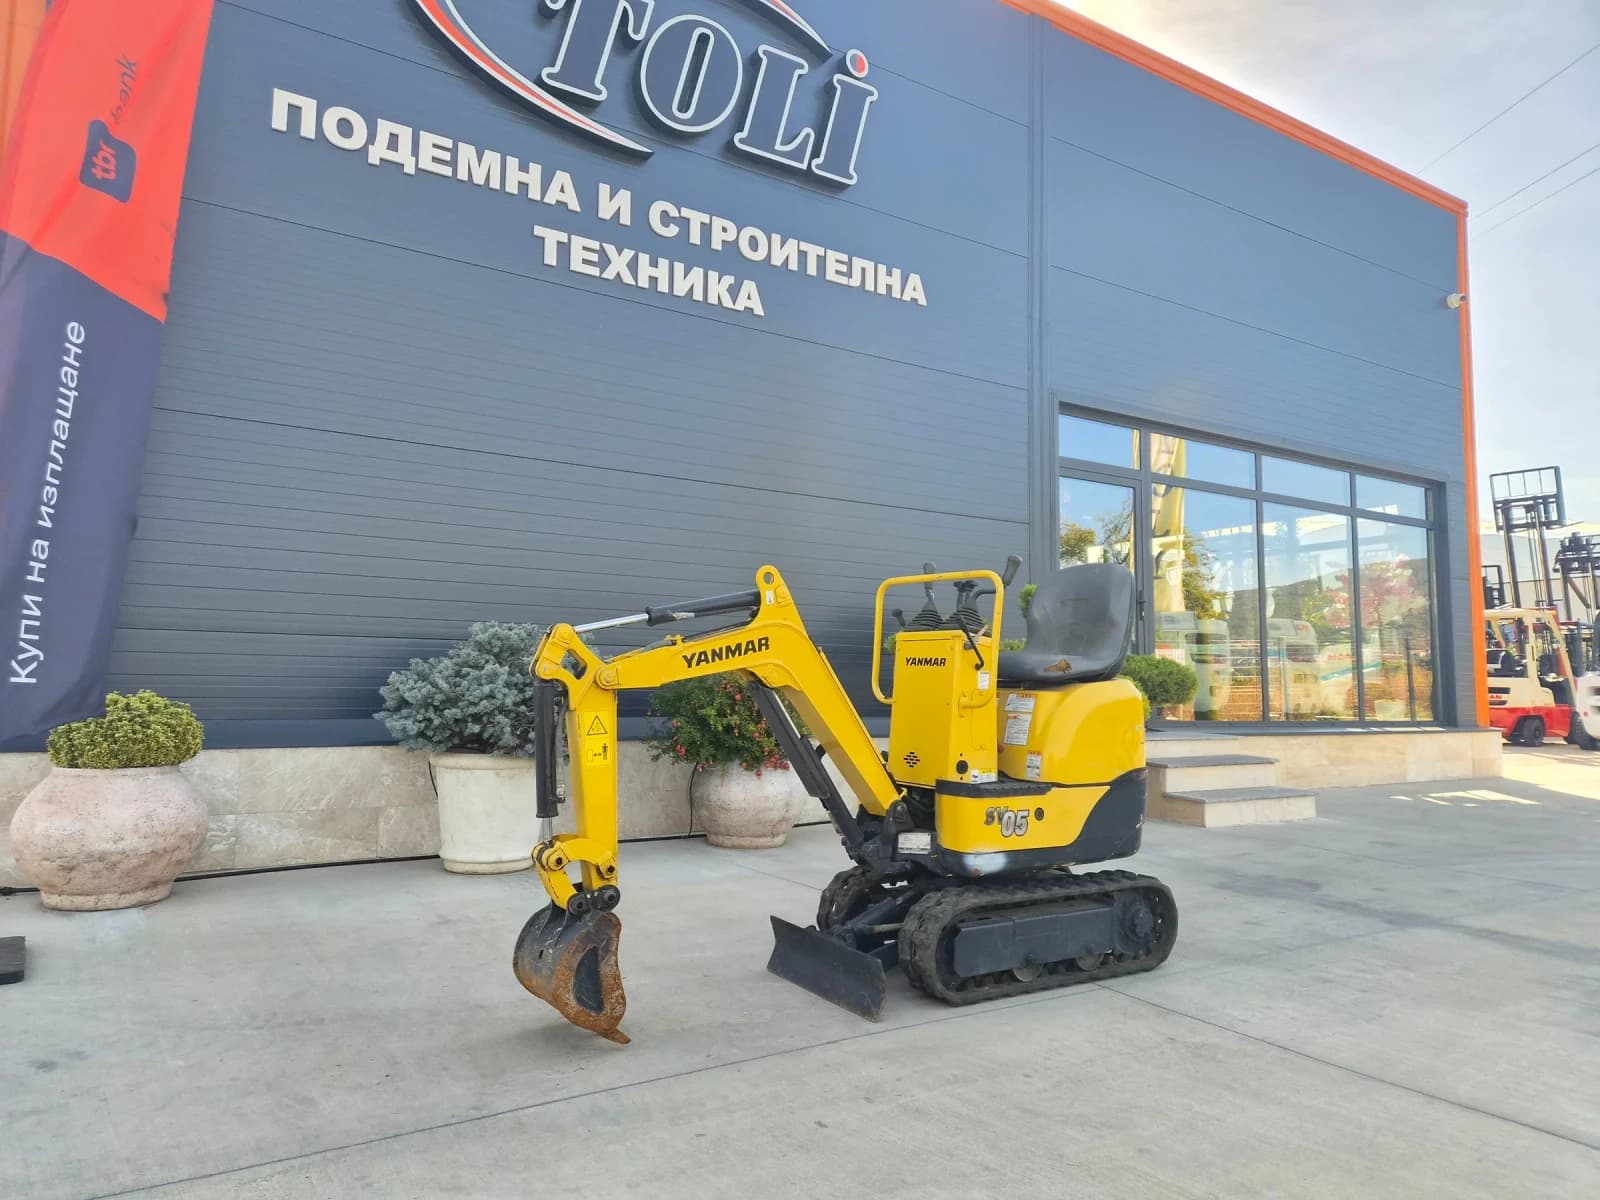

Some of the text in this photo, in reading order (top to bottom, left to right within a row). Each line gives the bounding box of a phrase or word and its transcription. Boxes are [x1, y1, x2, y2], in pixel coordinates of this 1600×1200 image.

[271, 87, 928, 305] ПОДЕМНА И СТРОИТЕЛНА
[533, 224, 765, 316] ТЕХНИКА
[10, 321, 85, 684] Купи на изплащане
[681, 636, 770, 669] YANMAR
[905, 656, 947, 667] YANMAR
